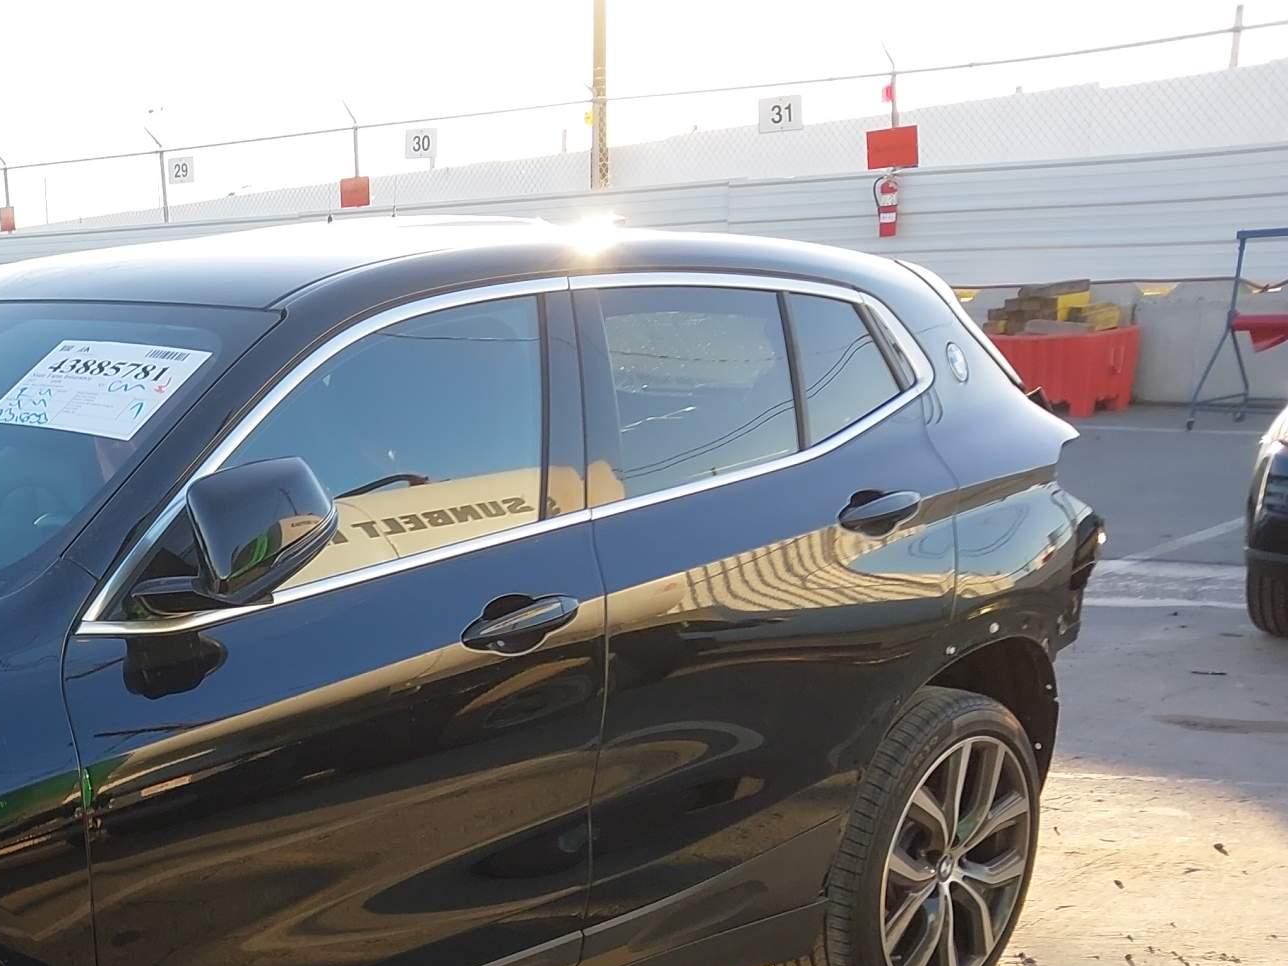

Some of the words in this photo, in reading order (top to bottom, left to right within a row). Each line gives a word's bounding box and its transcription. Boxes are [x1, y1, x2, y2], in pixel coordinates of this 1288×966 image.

[771, 103, 792, 124] 31
[412, 134, 431, 152] 30
[174, 162, 188, 178] 29
[48, 358, 170, 382] 43885781
